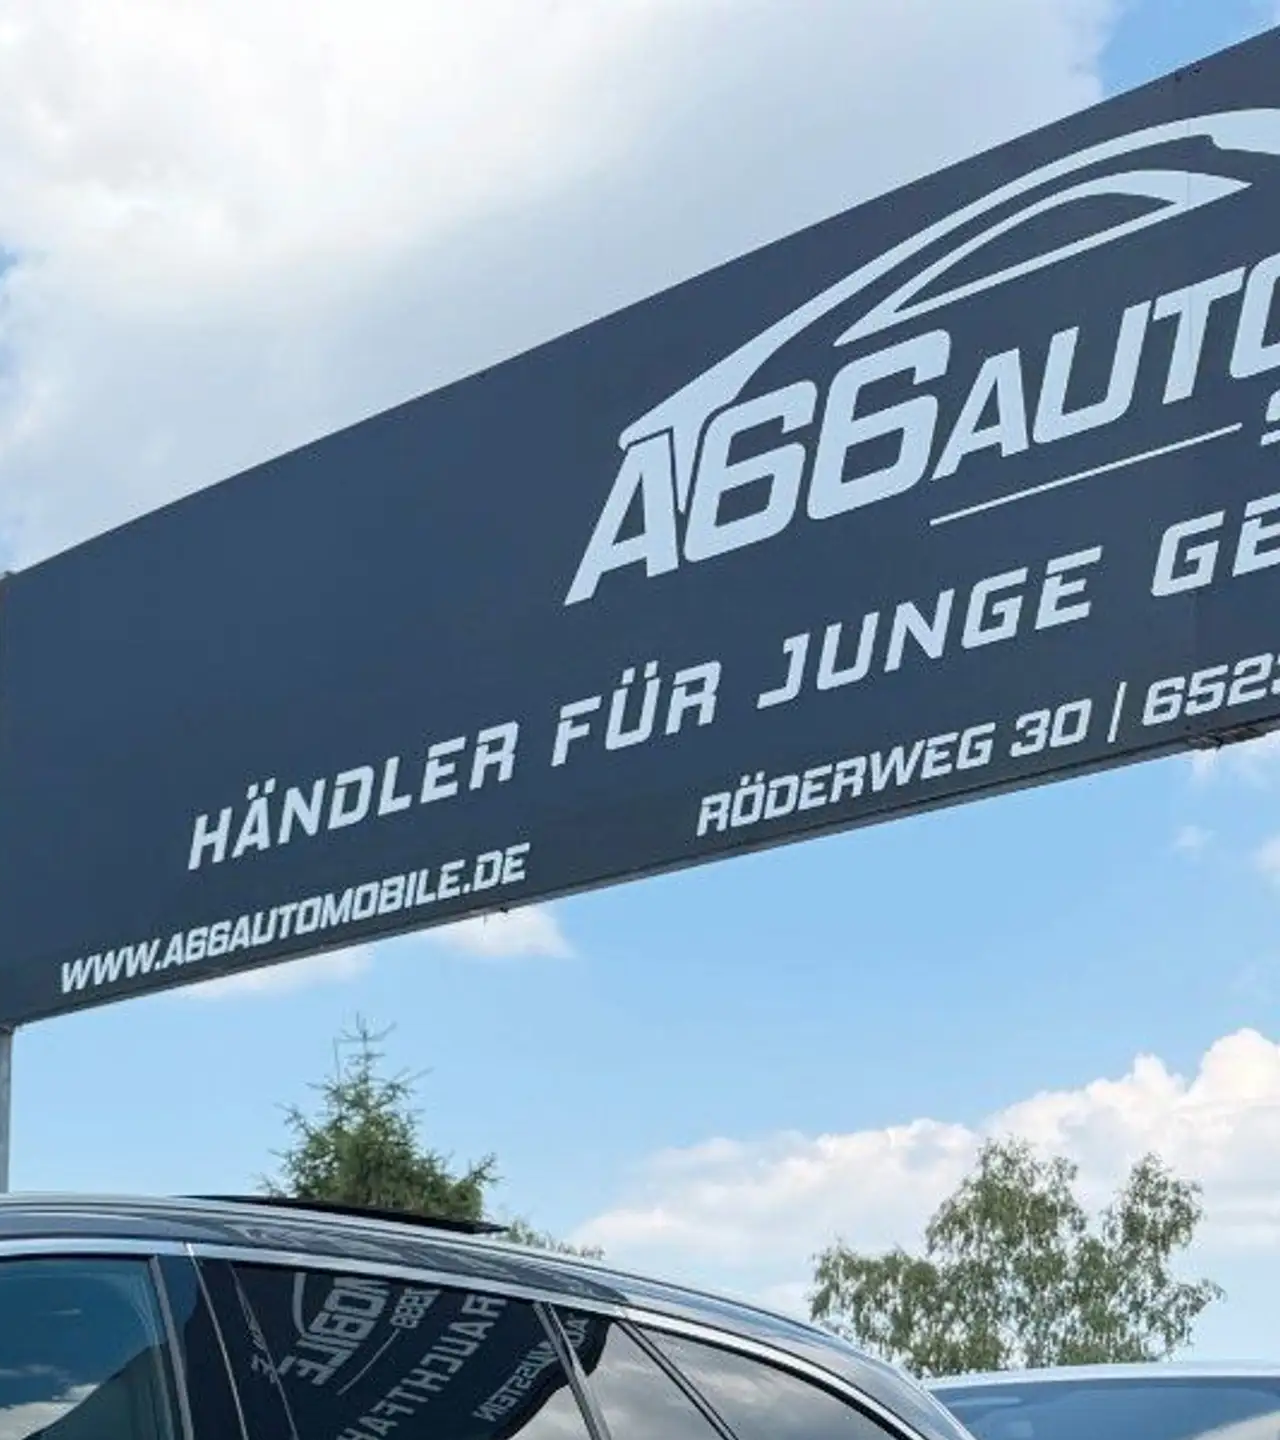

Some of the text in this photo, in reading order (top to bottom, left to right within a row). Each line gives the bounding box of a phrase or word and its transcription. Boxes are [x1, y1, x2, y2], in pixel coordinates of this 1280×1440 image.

[188, 720, 519, 870] HÄNDLER
[551, 660, 722, 767] FÜR
[757, 545, 1103, 709] JUNGE
[697, 722, 996, 837] RÖDERWEG
[1009, 698, 1092, 758] 30
[1142, 652, 1280, 727] 652
[60, 842, 531, 994] WWW.A66AUTOMOBILE.DE
